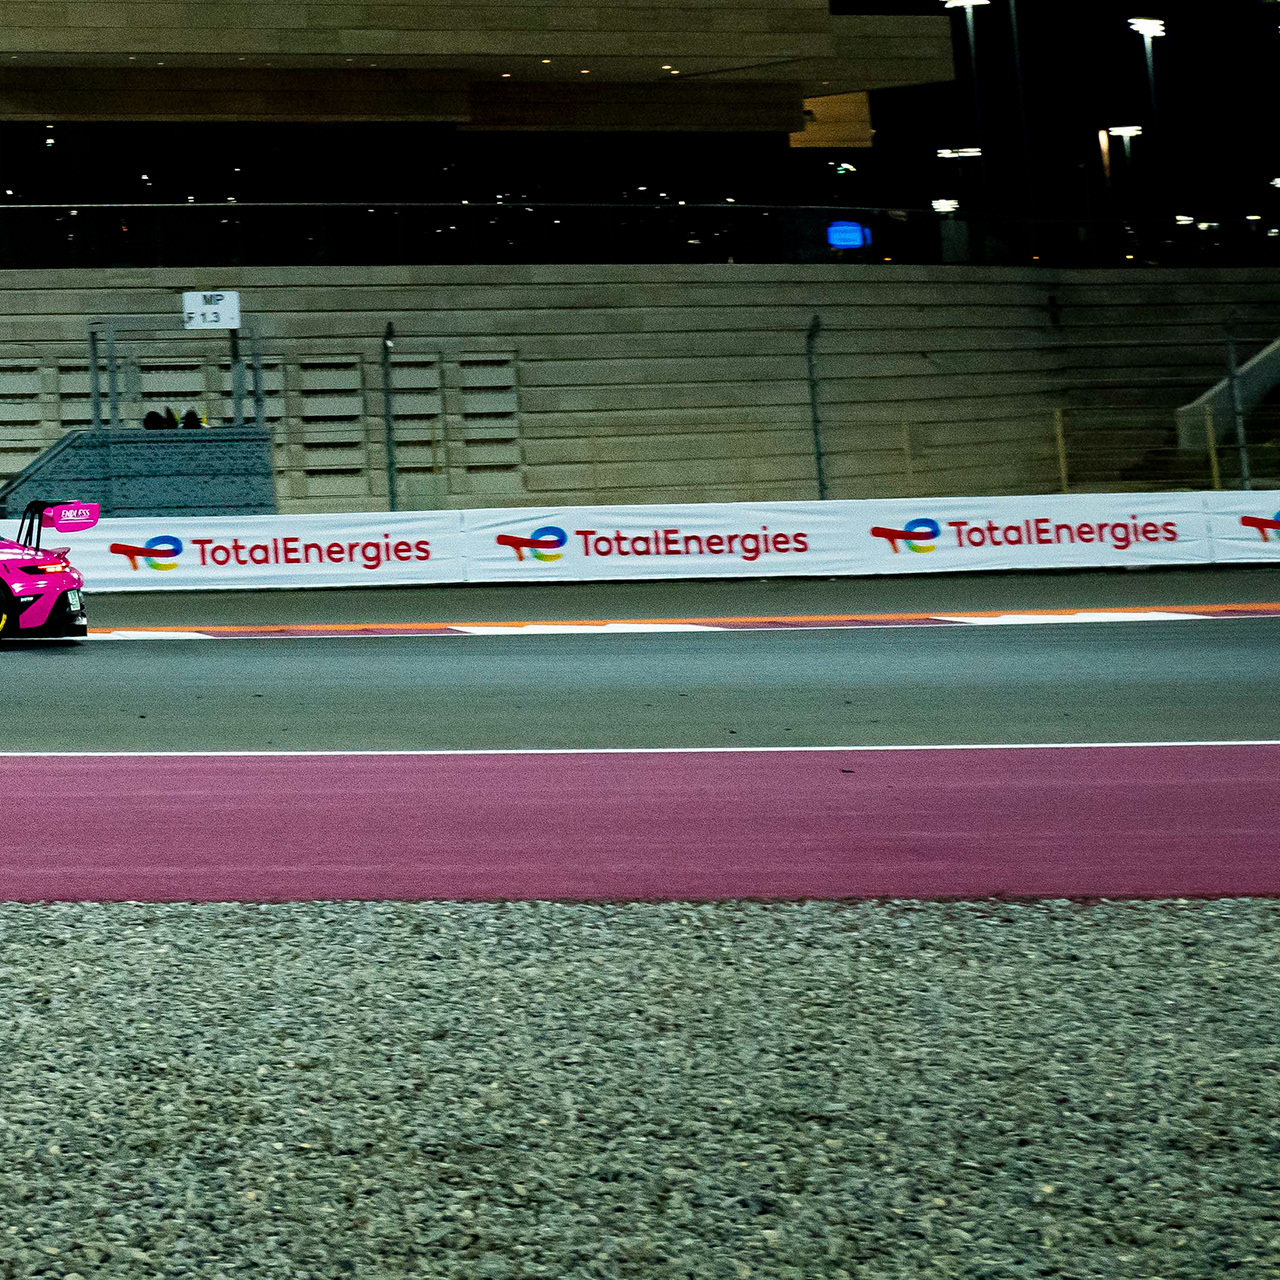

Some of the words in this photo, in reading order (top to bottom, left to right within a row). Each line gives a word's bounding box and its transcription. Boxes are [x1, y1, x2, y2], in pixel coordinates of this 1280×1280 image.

[60, 509, 90, 518] ENDLESS
[574, 525, 809, 562] TotalEnergies
[946, 514, 1178, 551] TotalEnergies
[190, 533, 432, 570] TotalEnergies
